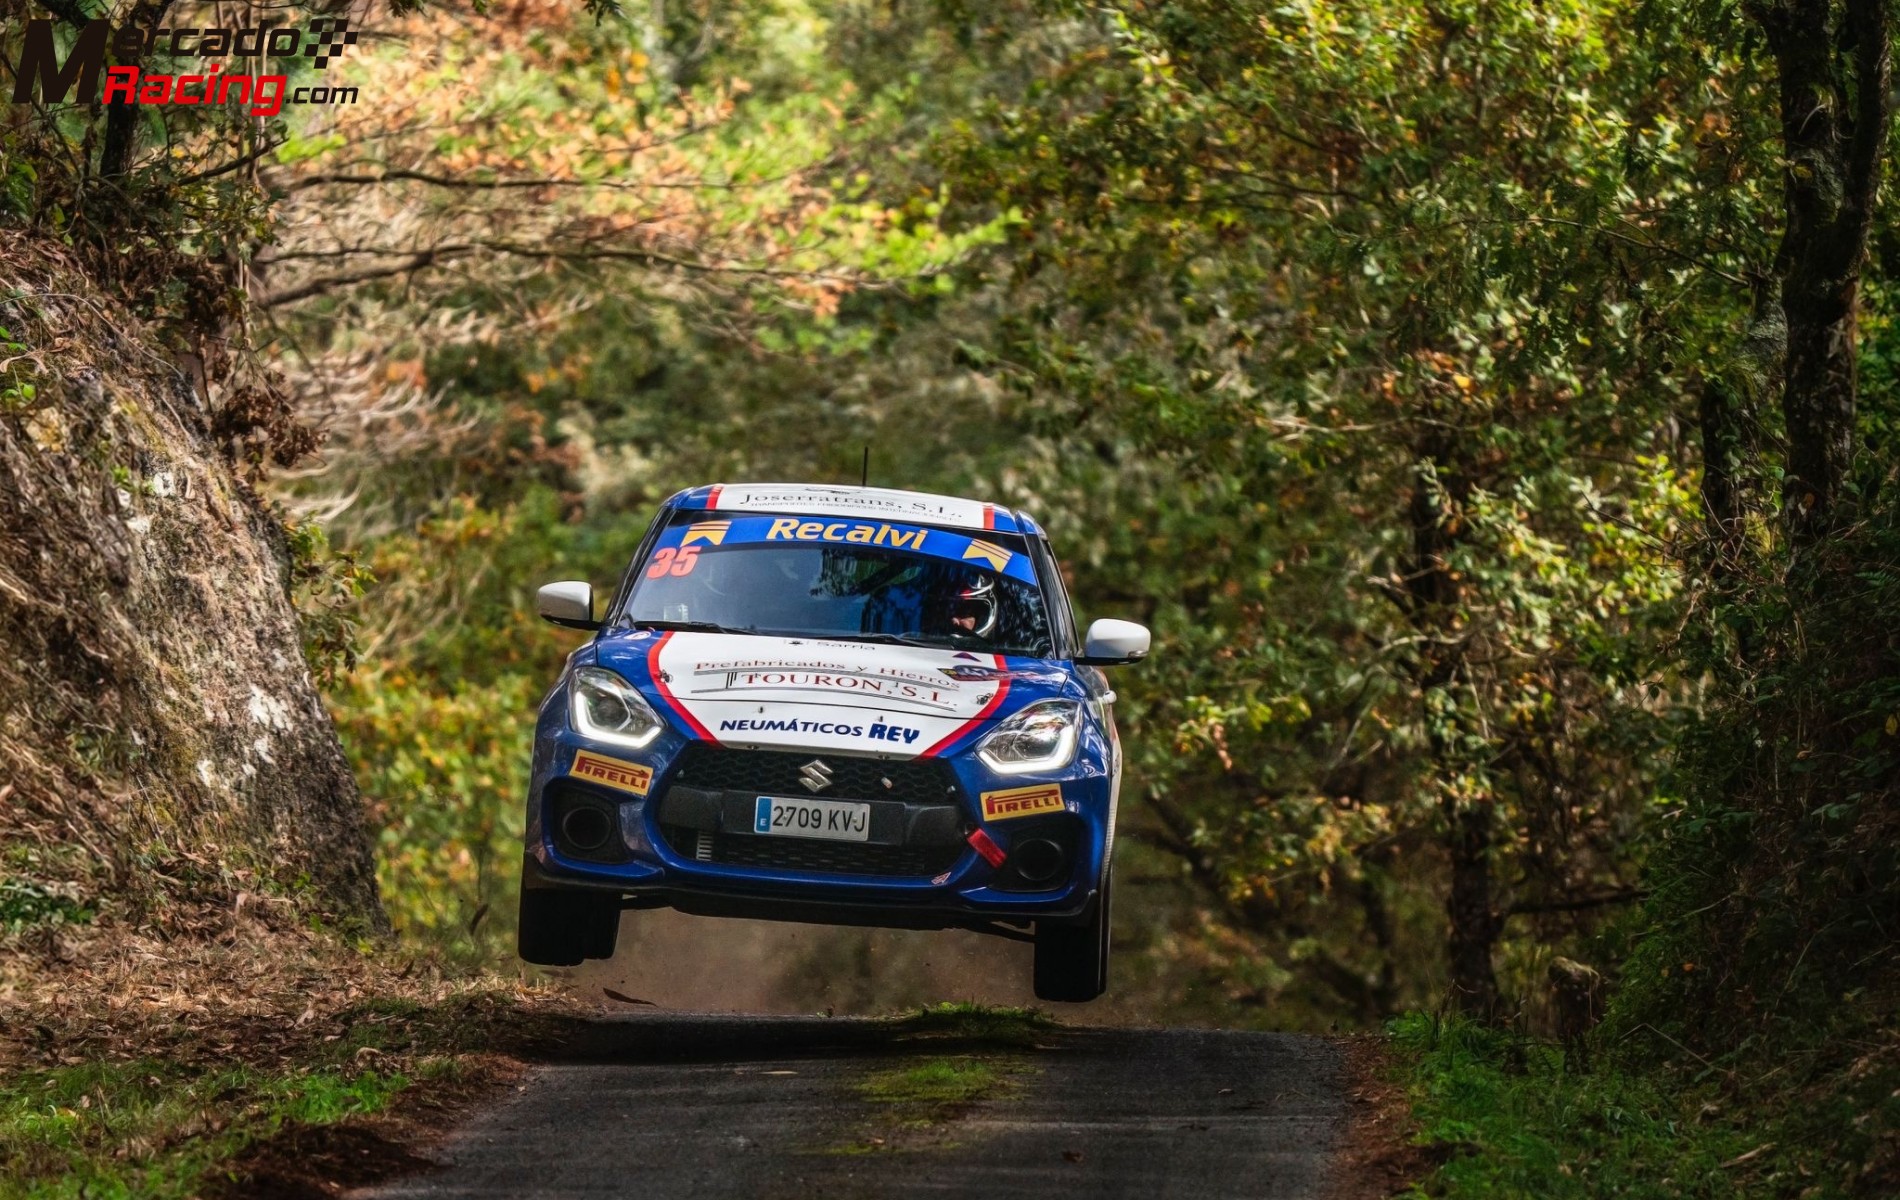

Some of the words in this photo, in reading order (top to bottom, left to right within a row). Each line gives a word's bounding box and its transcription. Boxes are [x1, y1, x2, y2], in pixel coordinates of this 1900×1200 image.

[766, 518, 929, 550] Recalvi
[646, 546, 702, 579] 35
[696, 659, 846, 670] Prefabricados
[879, 667, 960, 689] Hierros
[720, 718, 864, 737] NEUMÁTICOS
[868, 723, 920, 744] REY
[575, 756, 650, 789] PIRELLI
[984, 789, 1060, 815] PIRELLI
[760, 818, 767, 827] E
[772, 805, 822, 829] 2709
[828, 809, 866, 832] KVJ
